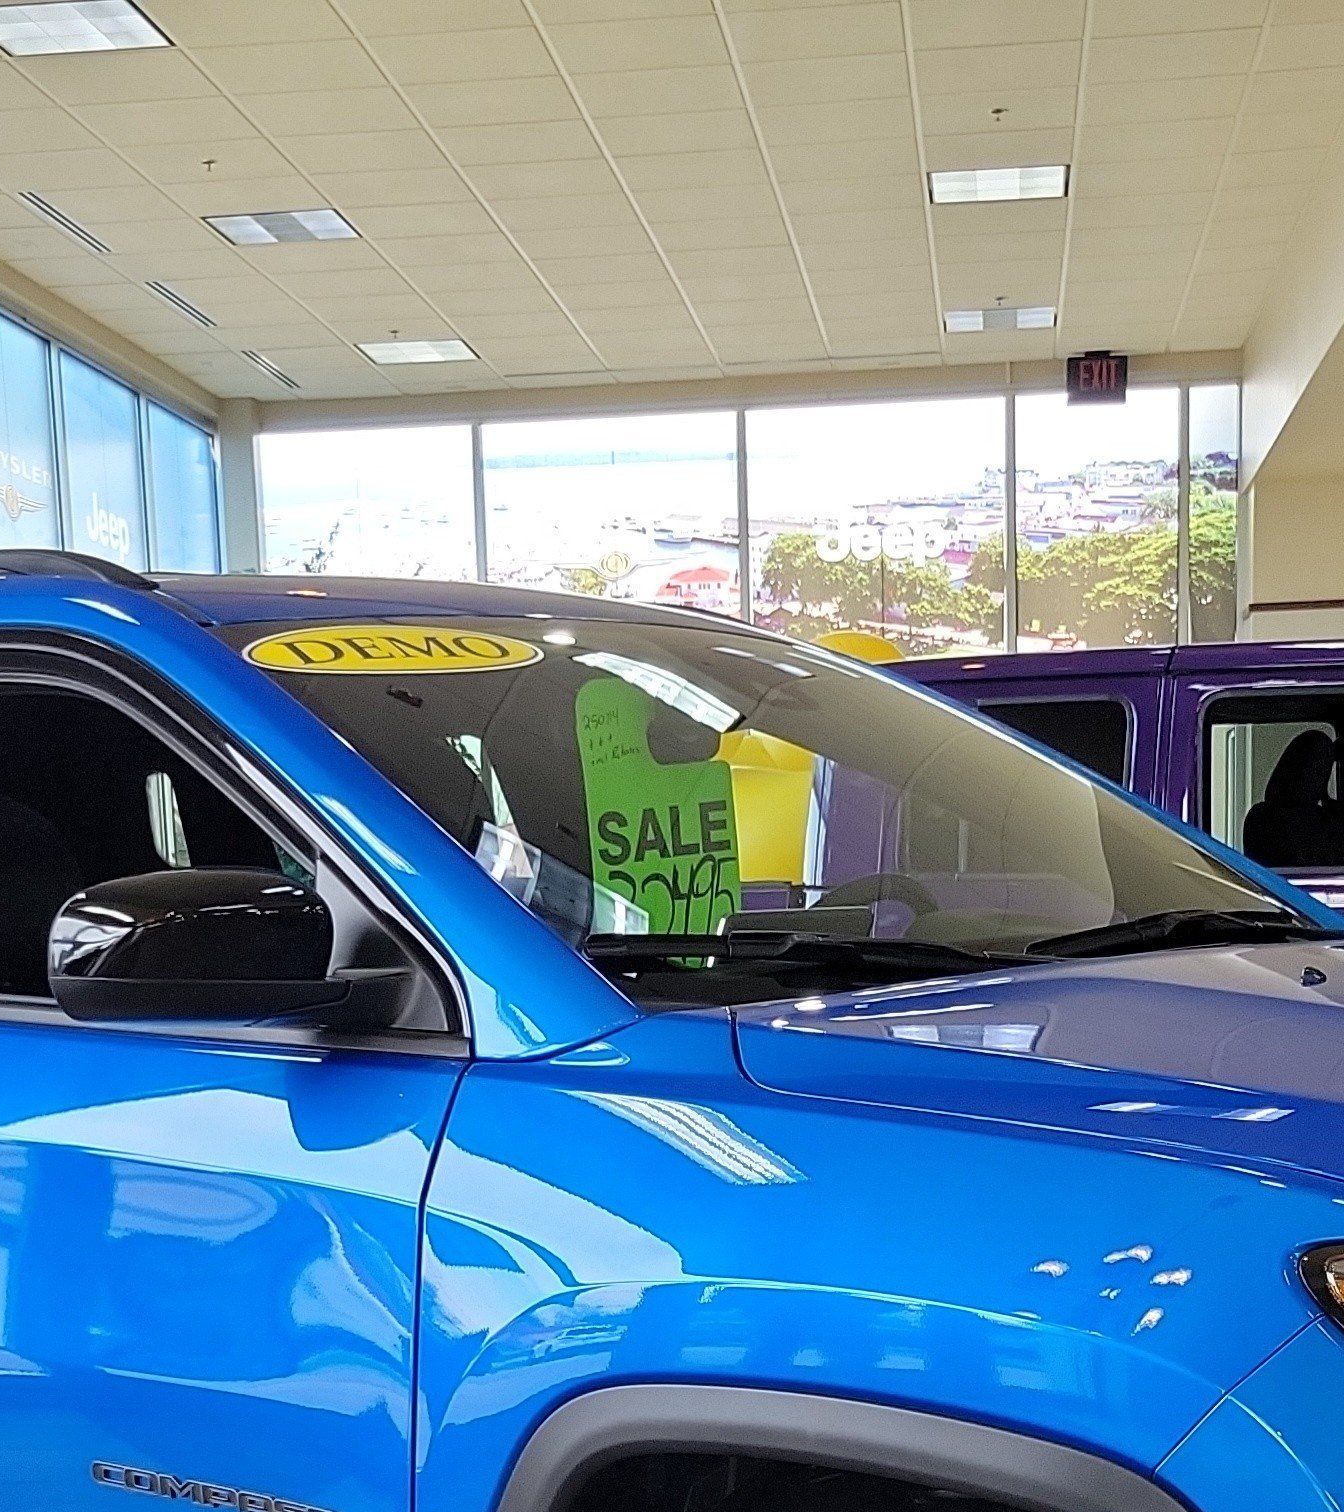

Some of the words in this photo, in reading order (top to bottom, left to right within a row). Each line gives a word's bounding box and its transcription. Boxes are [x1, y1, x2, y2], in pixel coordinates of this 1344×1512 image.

[1079, 359, 1118, 391] EXIT
[85, 491, 131, 563] Jeep
[282, 633, 511, 666] DEMO
[597, 799, 732, 866] SALE
